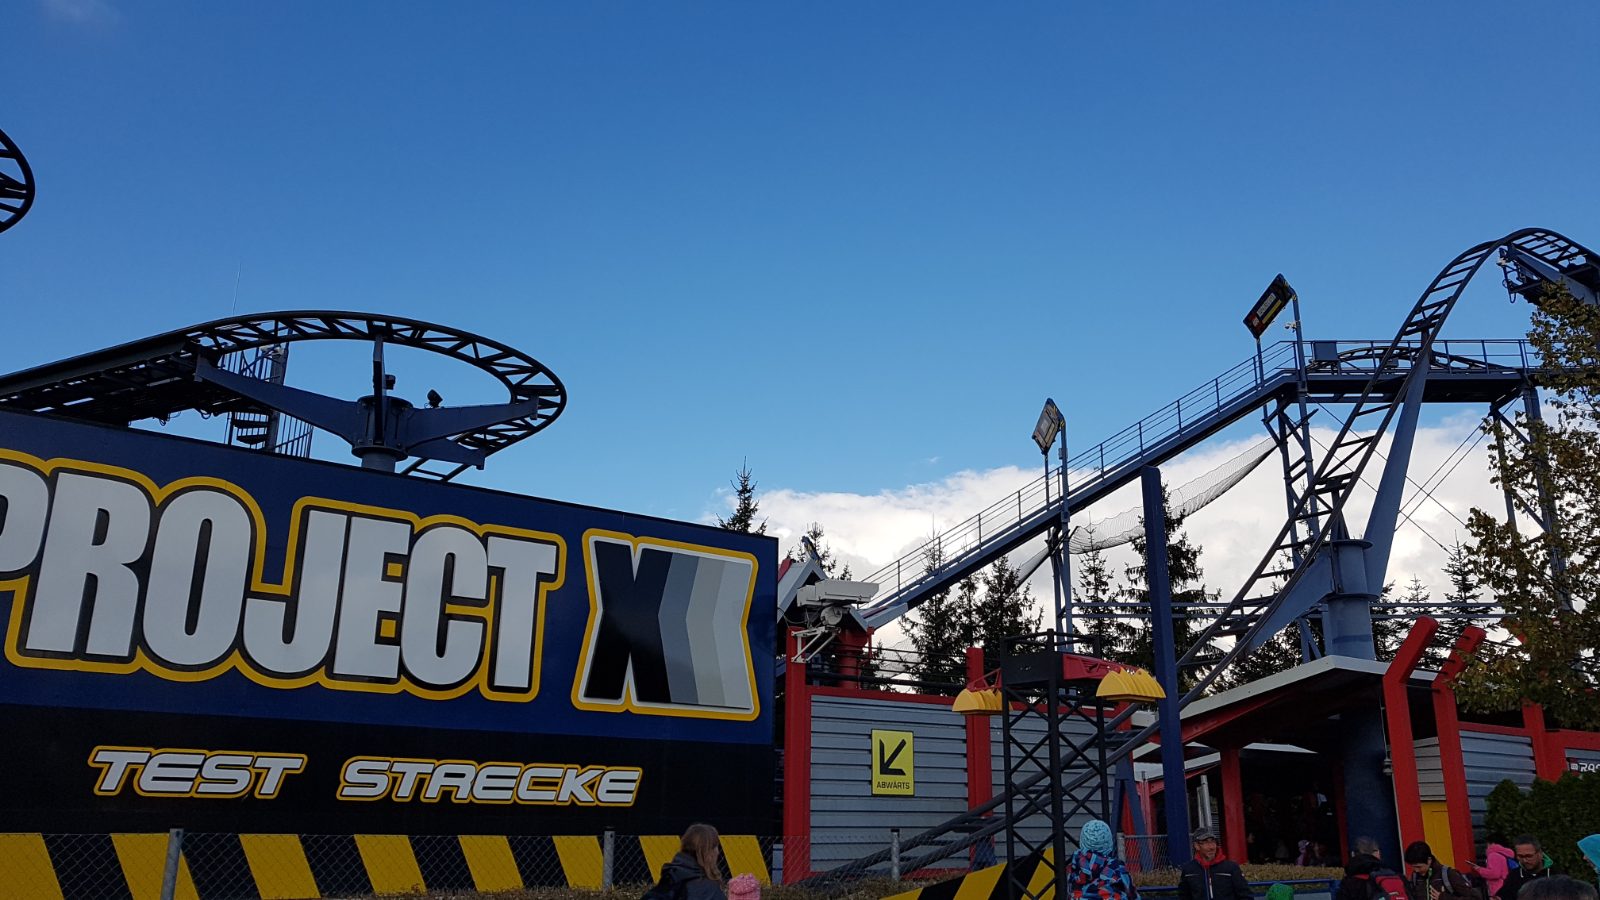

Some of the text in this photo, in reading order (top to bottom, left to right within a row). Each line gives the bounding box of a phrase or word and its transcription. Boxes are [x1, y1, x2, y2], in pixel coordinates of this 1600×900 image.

[575, 530, 760, 717] X
[91, 749, 641, 804] TEST STRECKE
